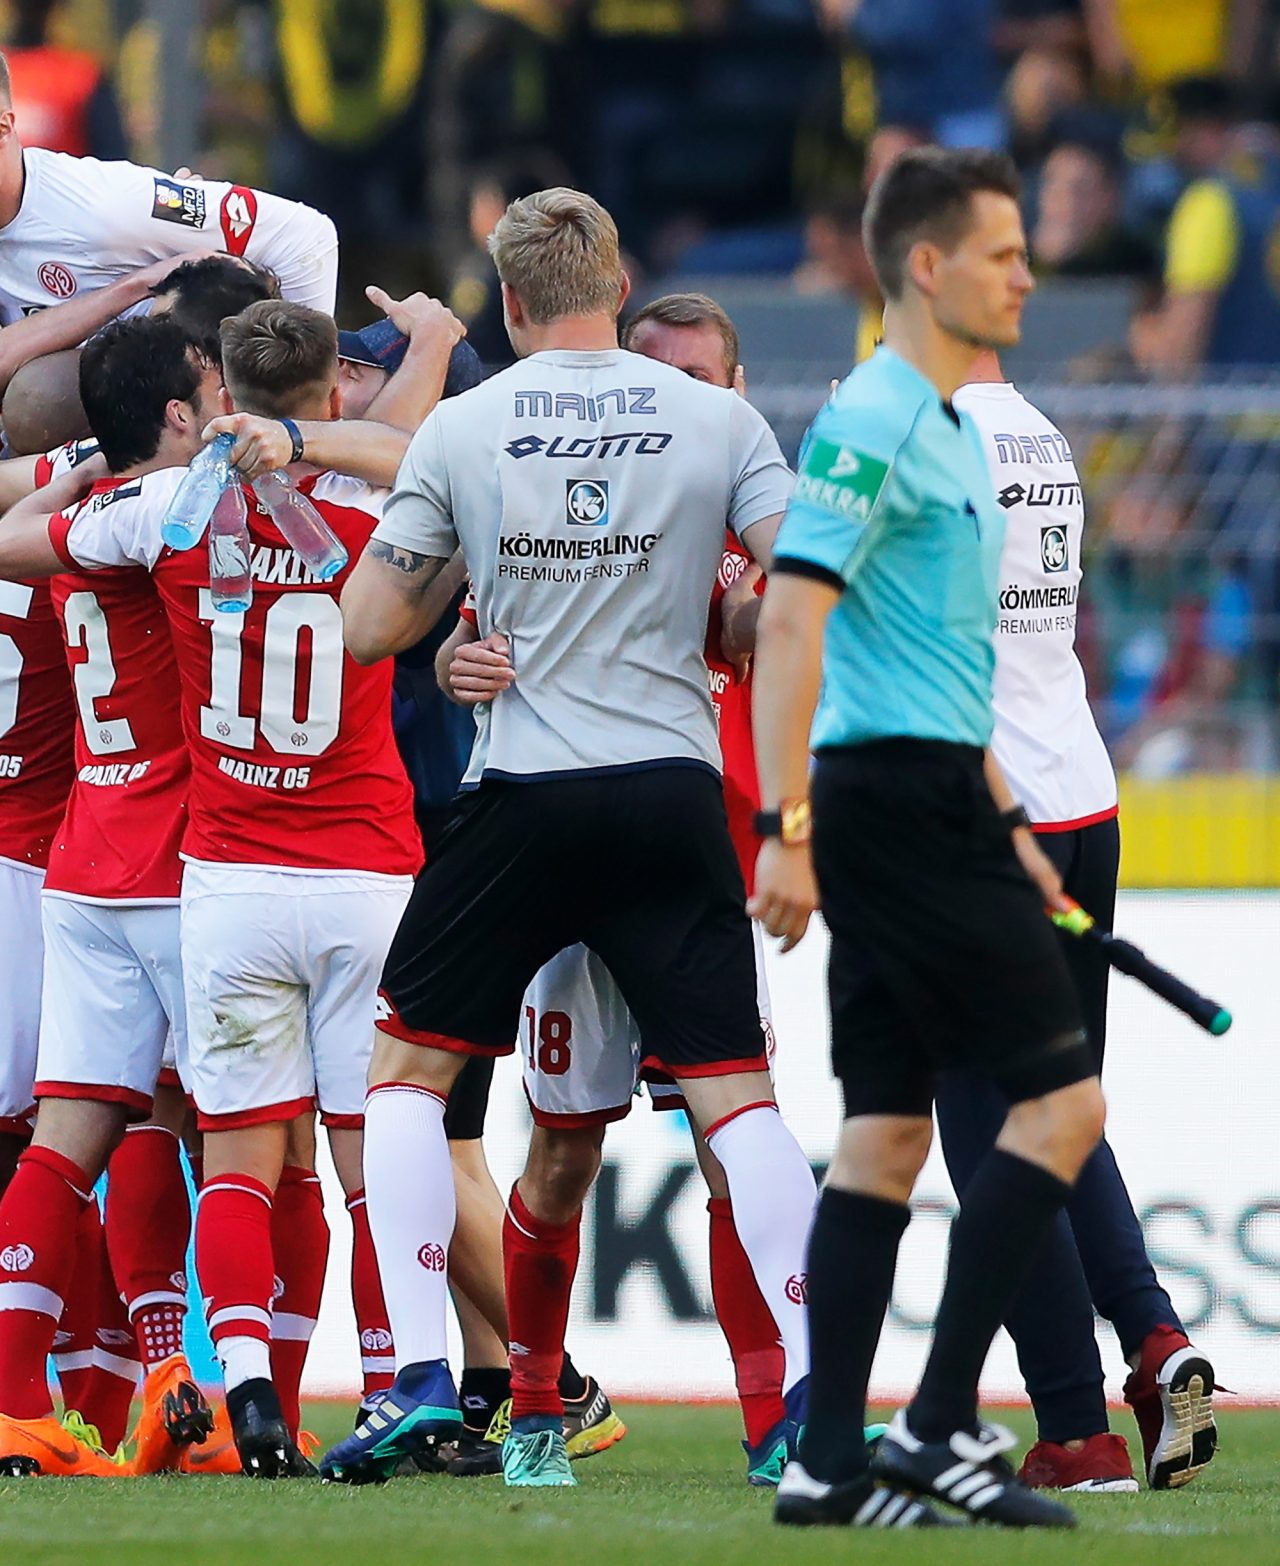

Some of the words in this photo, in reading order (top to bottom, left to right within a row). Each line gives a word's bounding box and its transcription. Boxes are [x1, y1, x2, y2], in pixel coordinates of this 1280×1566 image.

[181, 187, 196, 222] MFD
[1026, 482, 1081, 506] LOTT
[248, 542, 334, 585] AXI
[499, 532, 658, 560] KÖMMERLING
[498, 564, 581, 583] PREMIUM
[63, 591, 137, 755] 2
[198, 587, 345, 757] 10
[217, 756, 281, 789] MAINZ
[282, 766, 312, 790] 05
[525, 1004, 572, 1076] 18
